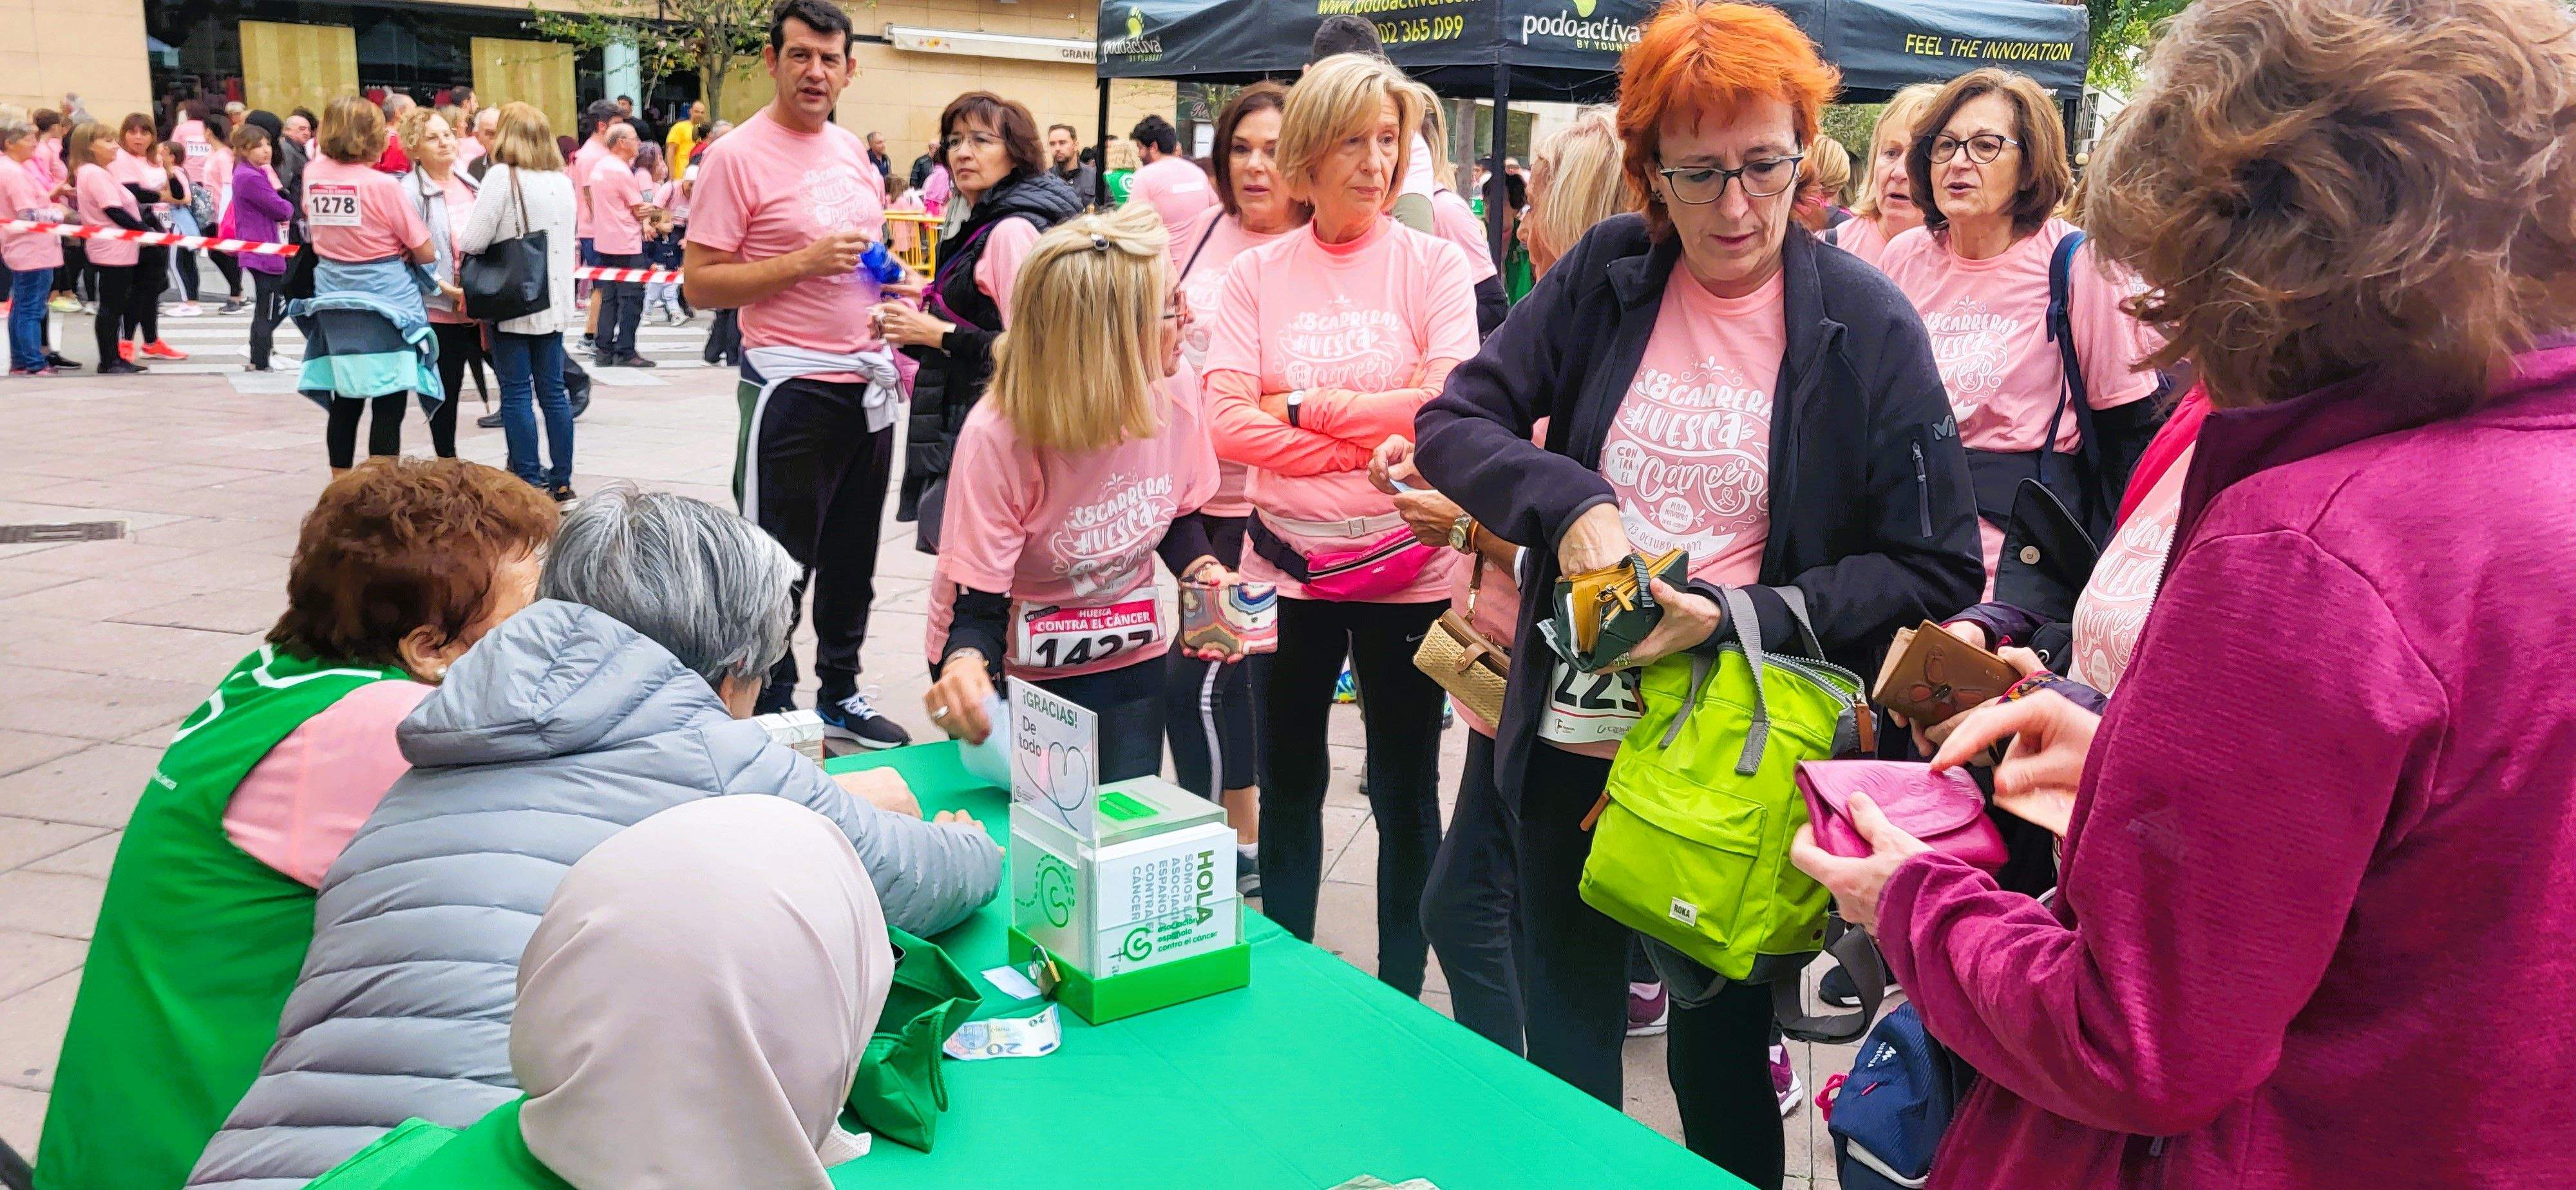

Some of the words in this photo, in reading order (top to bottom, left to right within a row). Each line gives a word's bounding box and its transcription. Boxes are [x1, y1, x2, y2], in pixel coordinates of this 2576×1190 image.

[1376, 22, 1398, 44] 02
[1401, 18, 1430, 42] 365
[1432, 14, 1463, 40] 099
[1522, 10, 1643, 45] podoactiva
[1102, 35, 1162, 63] podoactiva
[1577, 40, 1589, 49] BY
[1904, 33, 1944, 55] FEEL
[1949, 38, 1982, 58] THE
[1982, 41, 2074, 61] INNOVATION
[312, 196, 355, 214] 1278
[1294, 327, 1371, 358] HUESCA
[1625, 402, 1744, 450] HUESCA
[1616, 446, 1638, 457] CON
[1618, 458, 1634, 469] TRA
[1620, 471, 1629, 484] EL
[1075, 500, 1155, 554] HUESCA
[1036, 618, 1088, 632] CONTRA
[1091, 619, 1104, 629] EL
[1104, 610, 1150, 627] CÁNCER
[1023, 688, 1079, 730] ¡GRACIAS!
[1023, 715, 1037, 735] De
[1018, 732, 1042, 758] todo
[1144, 863, 1155, 919] CONTRA
[1184, 853, 1193, 902] SOMOS
[1197, 849, 1215, 927] HOLA
[1131, 865, 1143, 921] CÁNCER
[1674, 903, 1690, 918] ROKA
[1158, 938, 1183, 952] contra
[1184, 936, 1191, 945] el
[1028, 1013, 1047, 1028] 20
[986, 1042, 1023, 1055] 20
